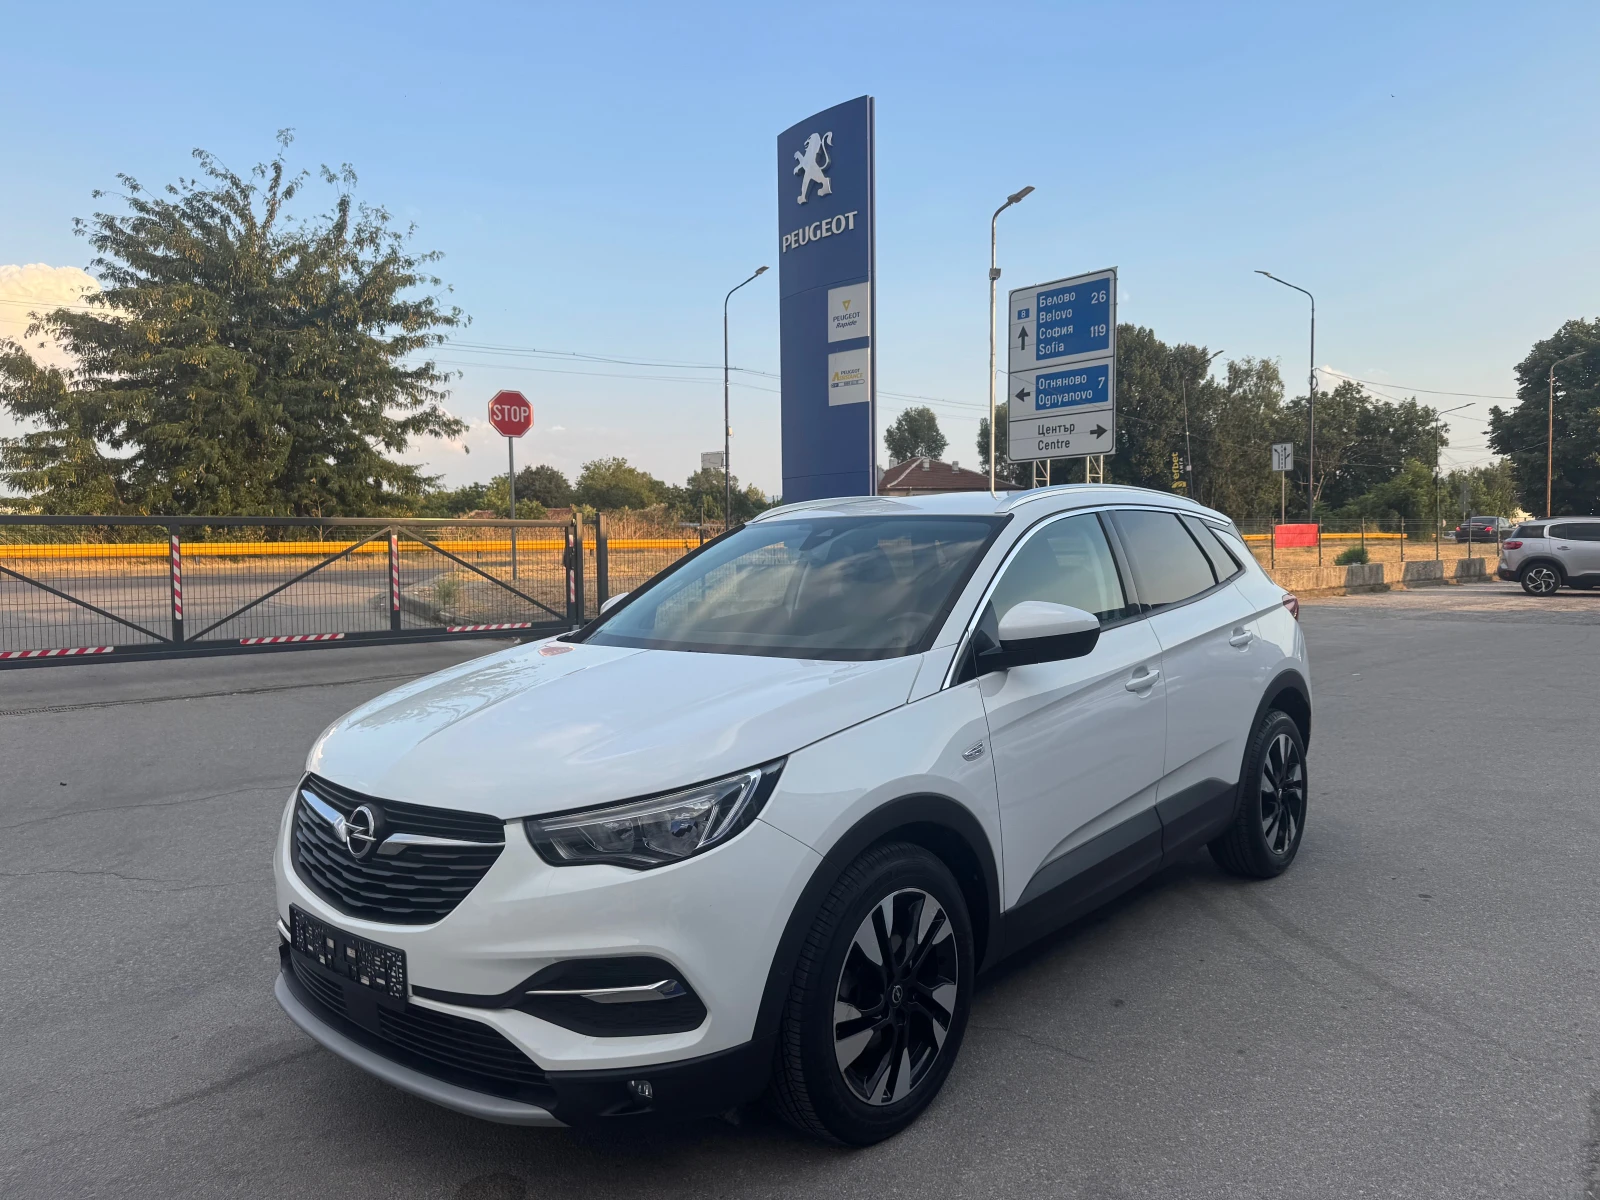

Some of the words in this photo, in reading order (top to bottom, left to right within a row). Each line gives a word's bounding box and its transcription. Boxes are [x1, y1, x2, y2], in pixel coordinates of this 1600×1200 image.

[782, 211, 858, 253] PEUGEOT
[1039, 292, 1076, 308] Белово
[1091, 290, 1107, 304] 26
[832, 311, 860, 323] PEUGEOT
[1021, 310, 1026, 318] 8
[1039, 308, 1073, 323] Belovo
[1039, 325, 1074, 339] София
[1090, 324, 1106, 338] 119
[1038, 341, 1065, 355] Sofia
[1038, 374, 1087, 390] Огняново
[1098, 377, 1106, 389] 7
[1038, 390, 1093, 407] Ognyanovo
[493, 404, 530, 423] STOP
[1037, 423, 1076, 436] Център
[1037, 439, 1071, 451] Centre
